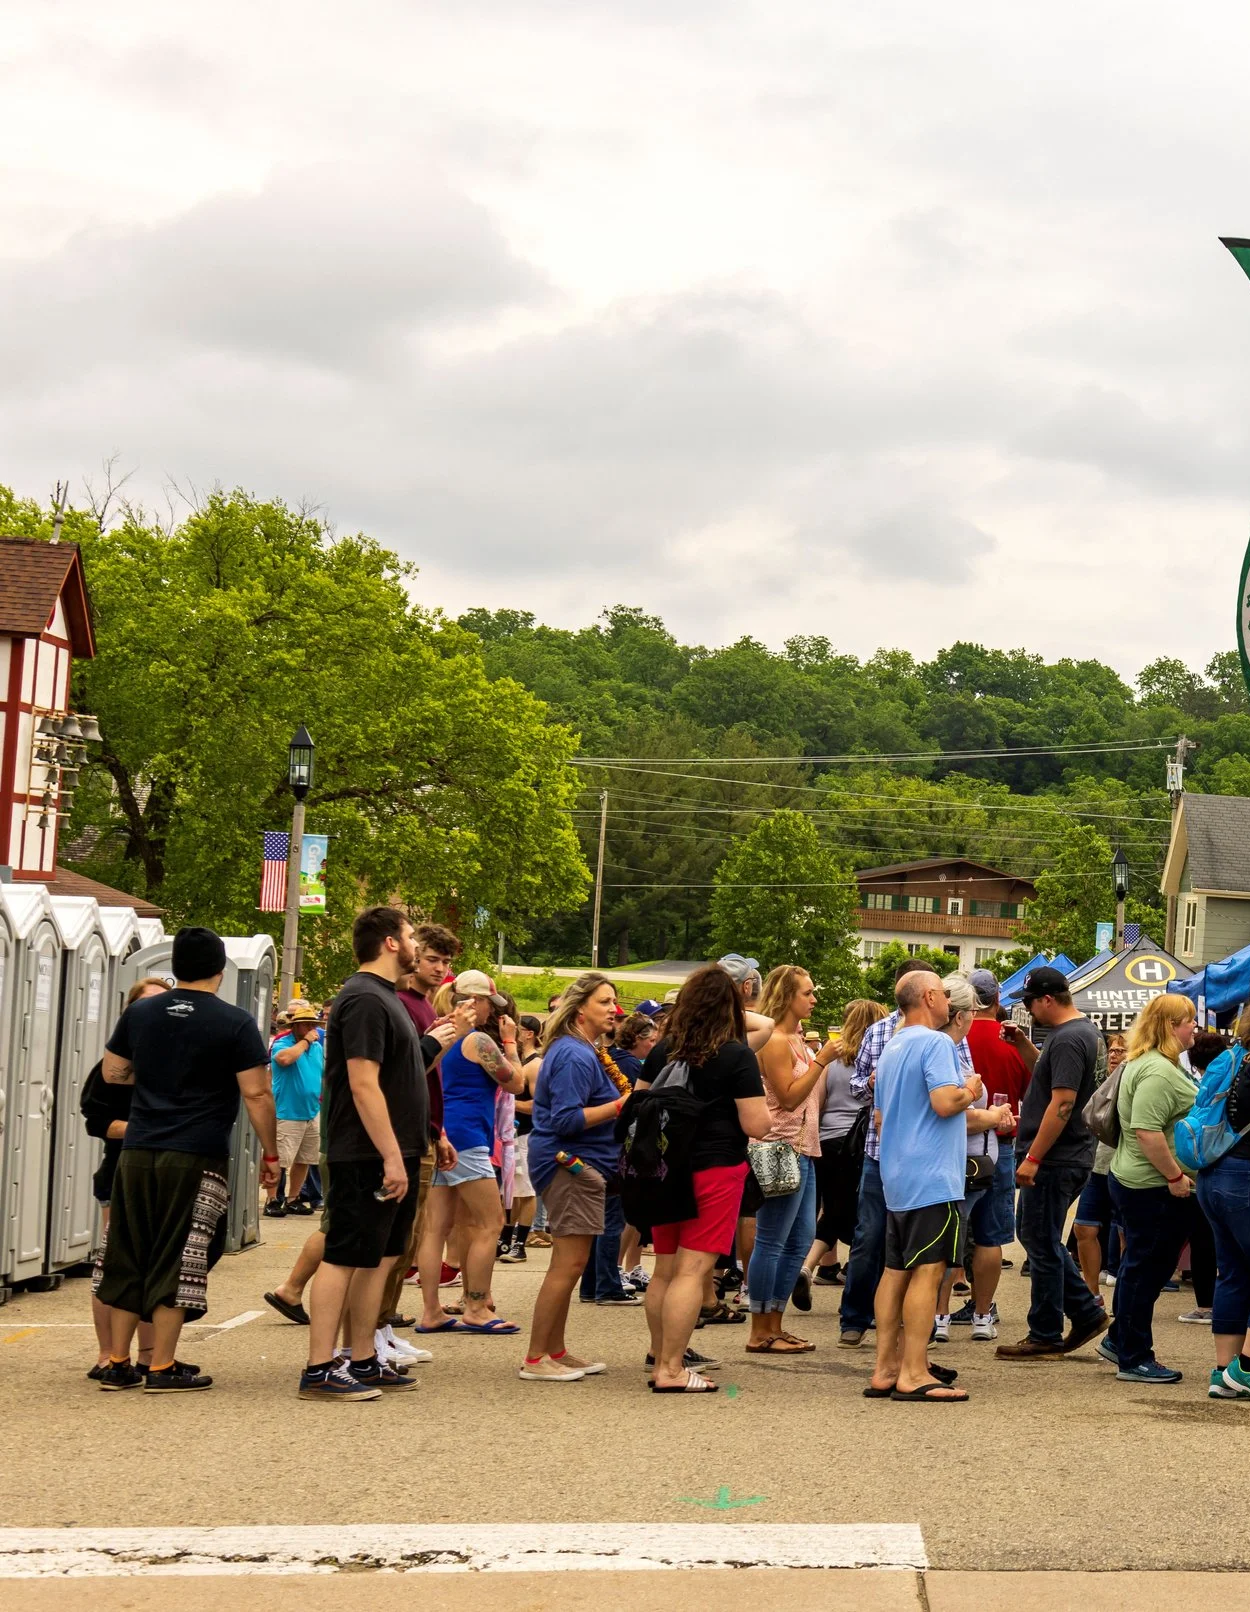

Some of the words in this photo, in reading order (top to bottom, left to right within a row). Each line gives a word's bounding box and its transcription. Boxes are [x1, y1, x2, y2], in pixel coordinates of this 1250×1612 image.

[1138, 962, 1163, 981] H
[1087, 990, 1166, 1000] HINTER
[1097, 1000, 1147, 1009] BRE
